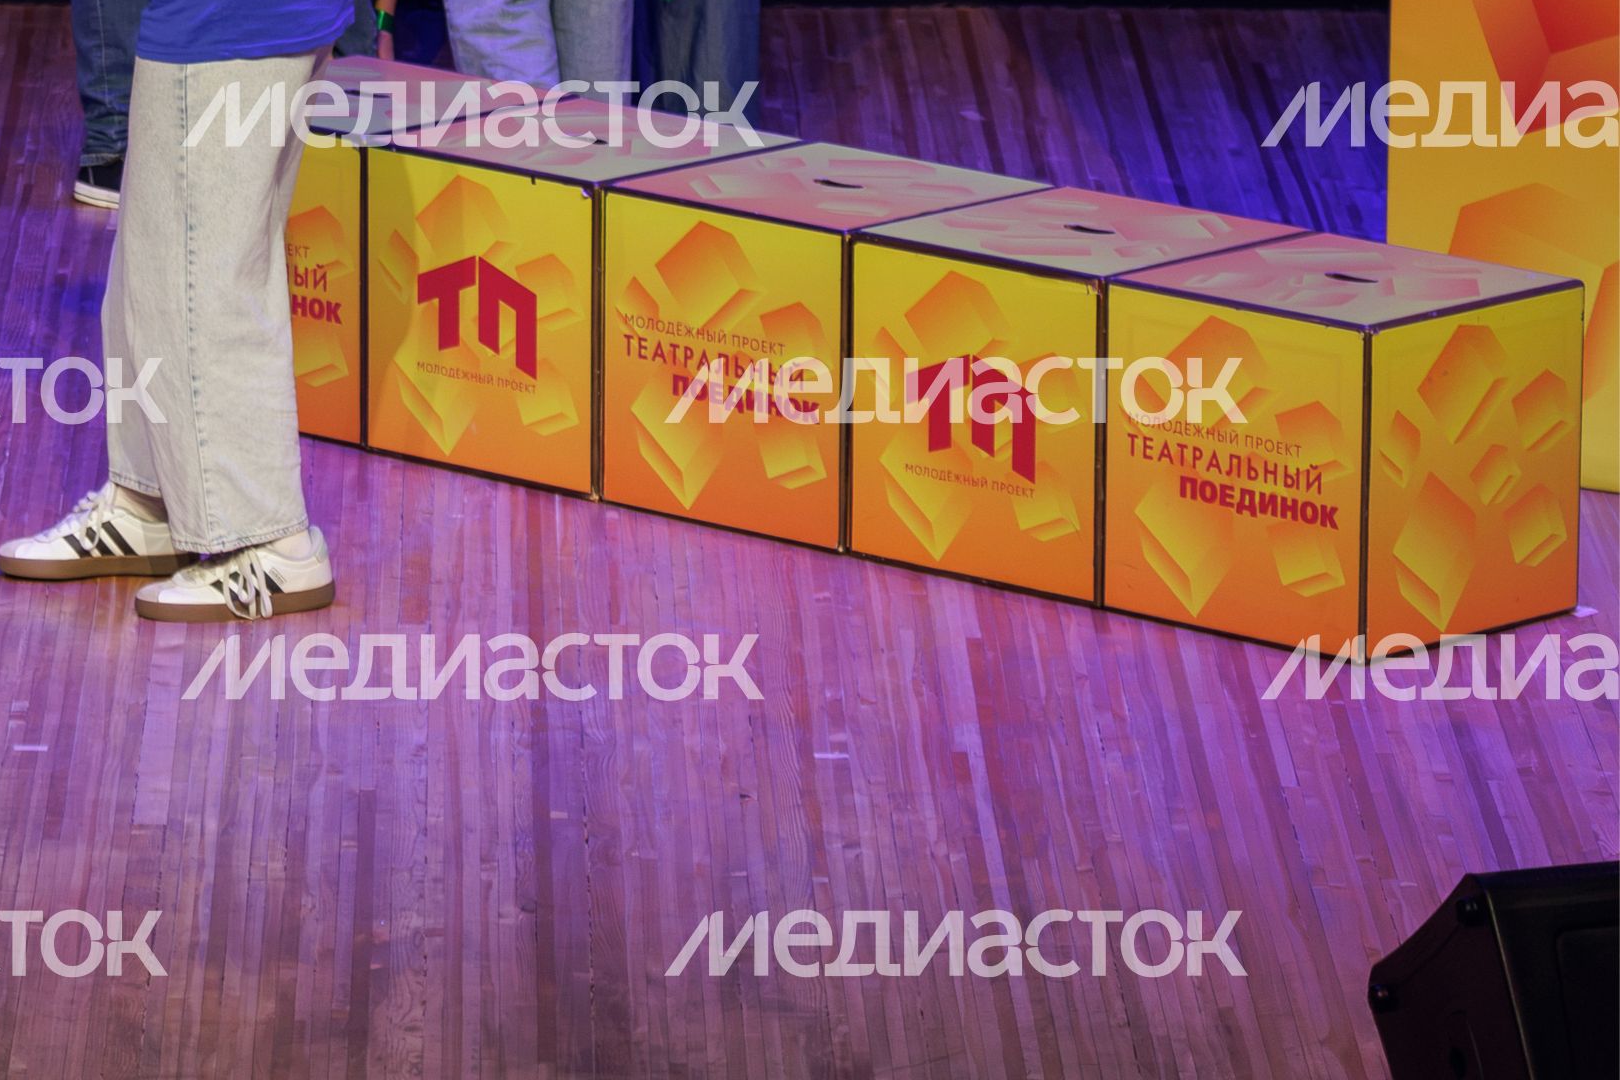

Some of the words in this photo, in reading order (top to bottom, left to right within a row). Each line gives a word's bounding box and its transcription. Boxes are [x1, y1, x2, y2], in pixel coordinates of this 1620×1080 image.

[417, 255, 537, 380] ТП
[623, 334, 805, 391] ТЕАТРАЛЬНЫЙ
[732, 334, 785, 356] ПРОЕКТ
[497, 377, 536, 394] ПРОЕКТ
[672, 374, 821, 424] ПОЕДИНОК
[1127, 433, 1322, 495] ТЕАТРАЛЬНЫЙ
[1244, 435, 1301, 458] ПРОЕКТ
[992, 480, 1035, 498] ПРОЕКТ
[1180, 475, 1339, 530] ПОЕДИНОК
